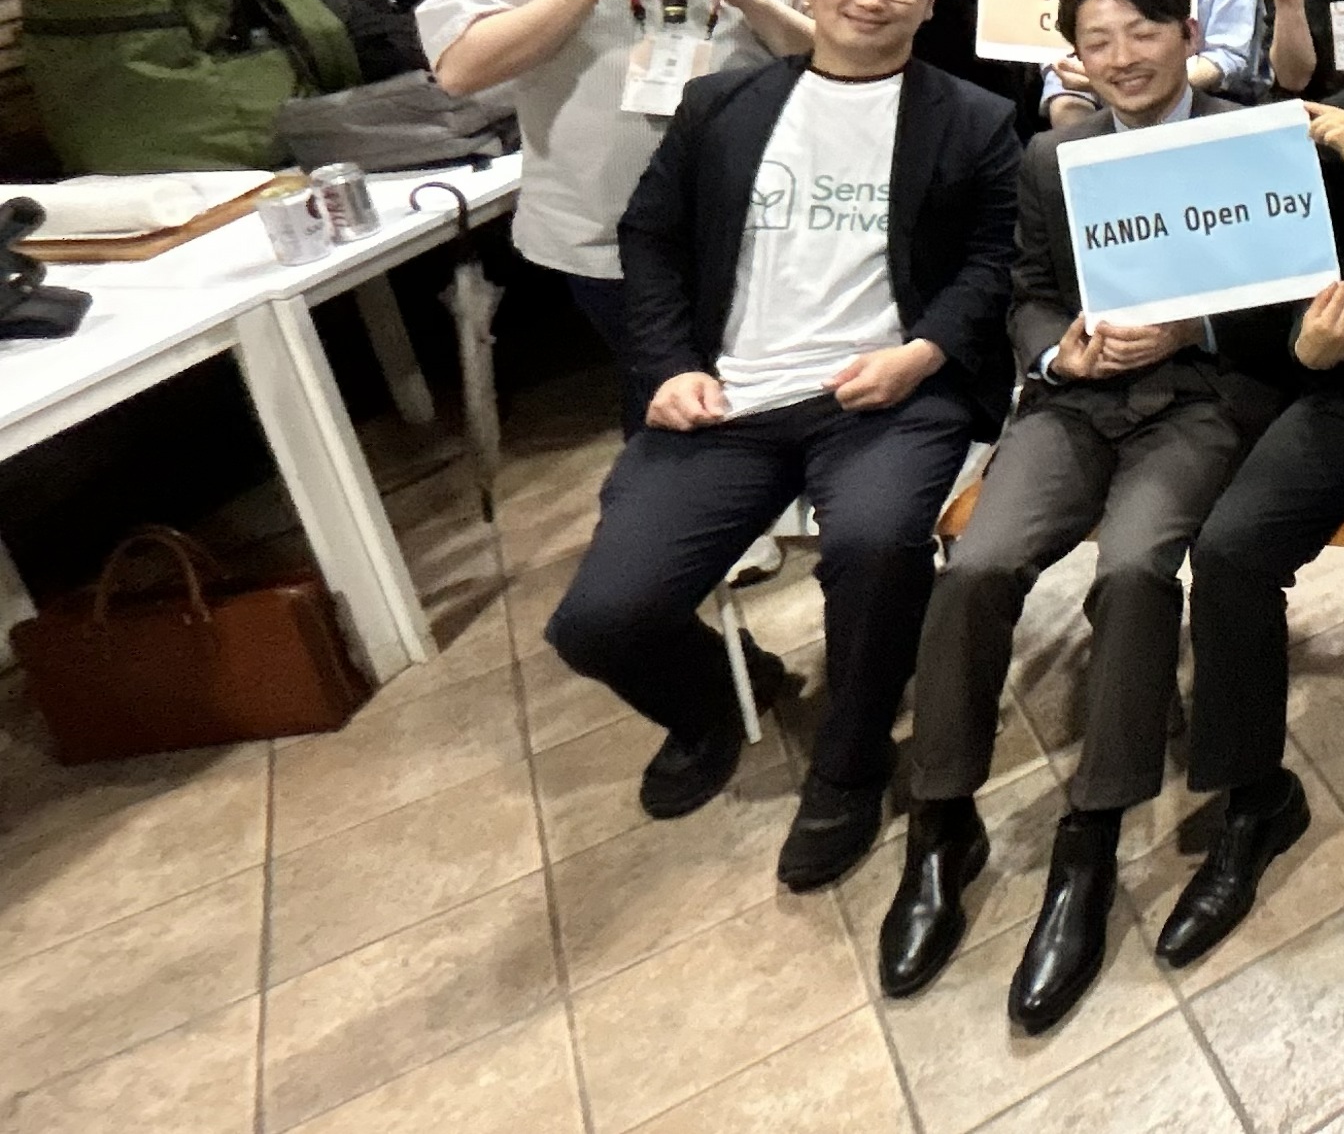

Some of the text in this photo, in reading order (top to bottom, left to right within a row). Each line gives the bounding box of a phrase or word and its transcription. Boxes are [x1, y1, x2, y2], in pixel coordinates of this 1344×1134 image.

[1085, 192, 1312, 250] KANDA Open Day
